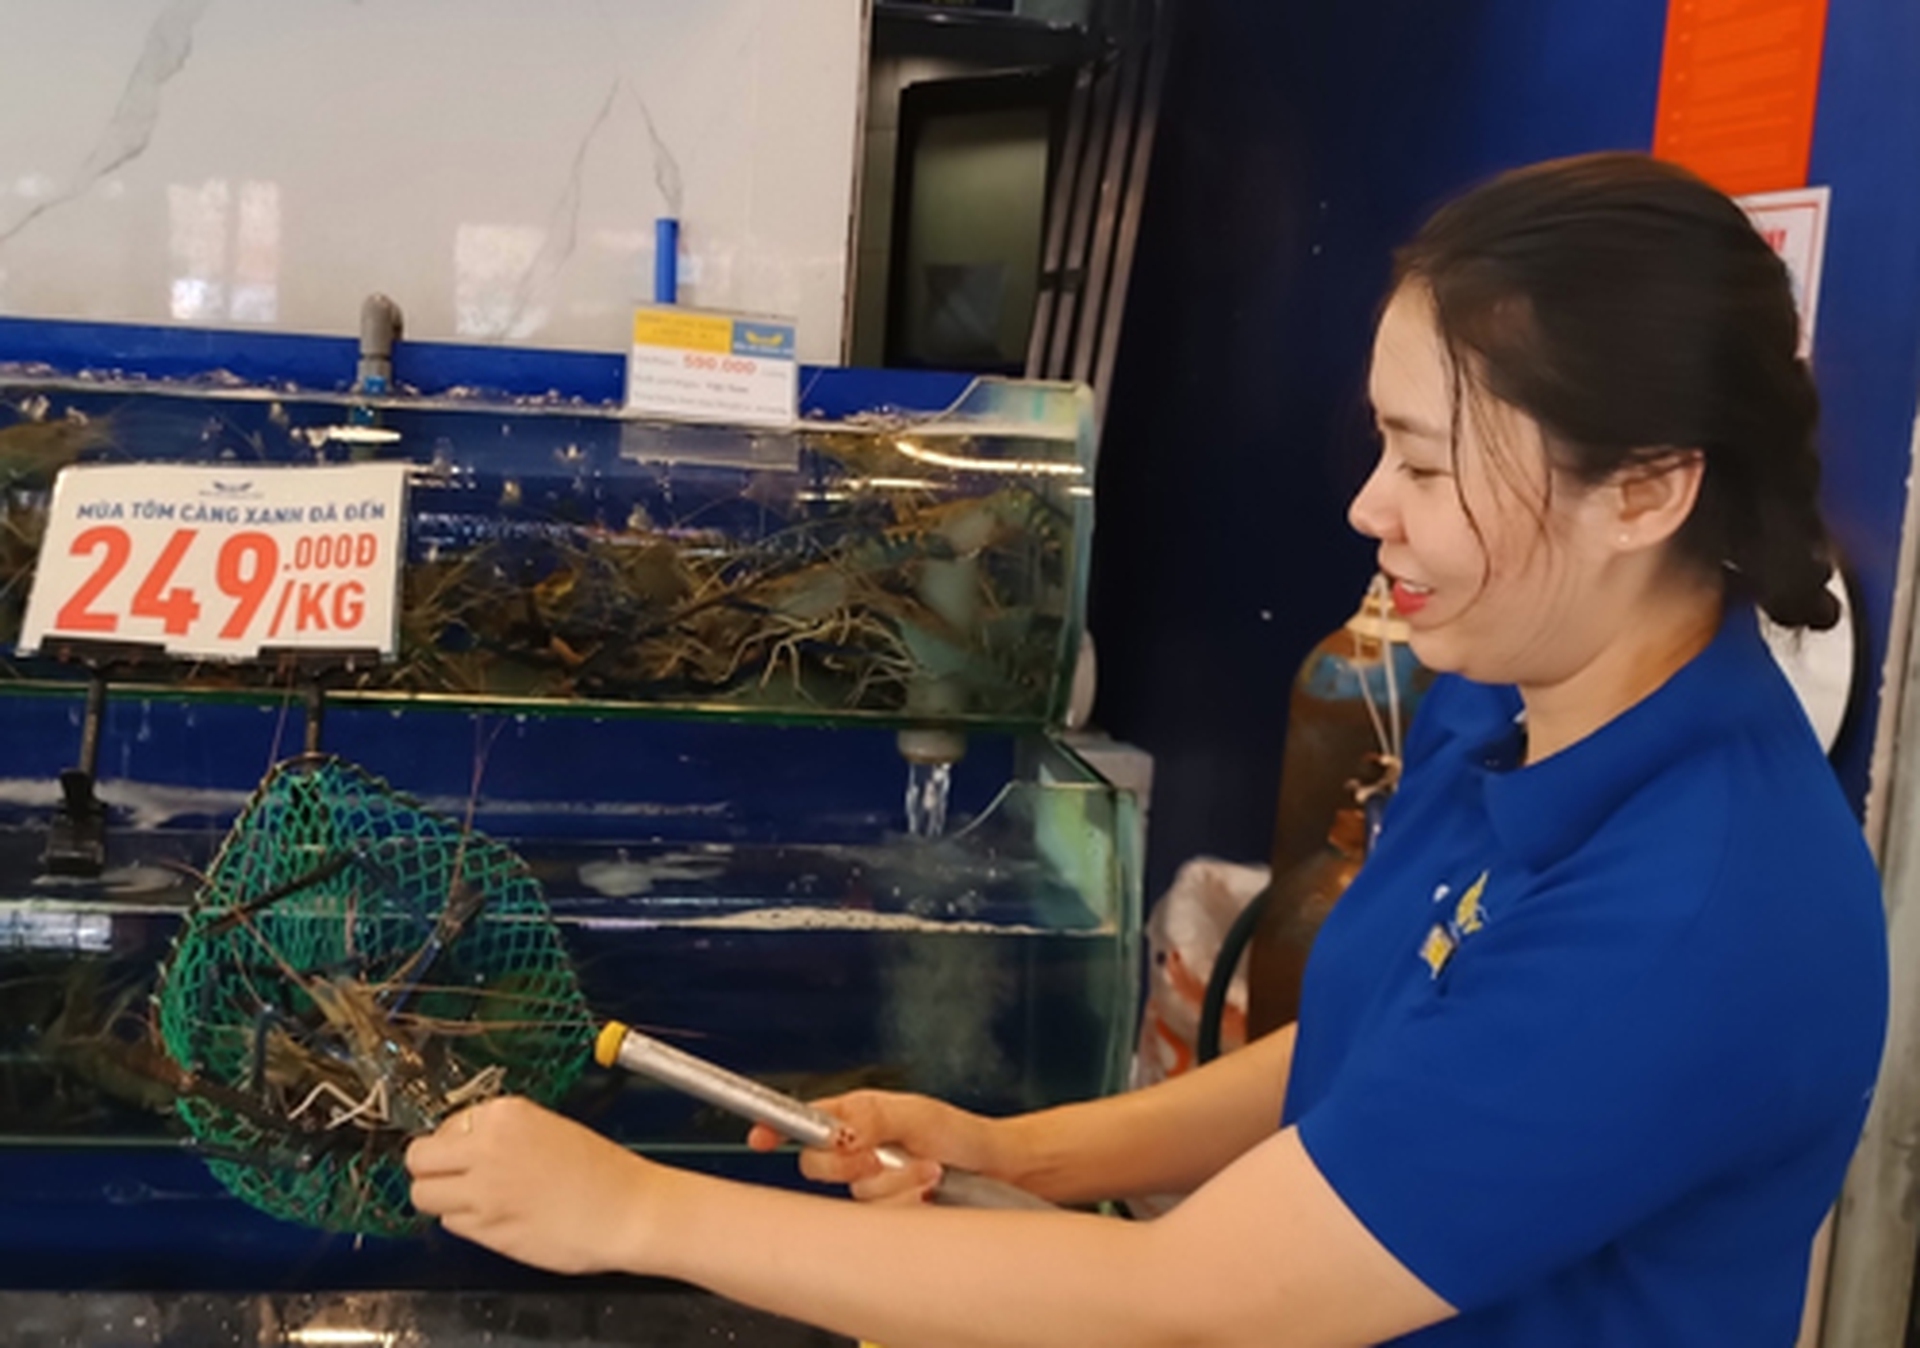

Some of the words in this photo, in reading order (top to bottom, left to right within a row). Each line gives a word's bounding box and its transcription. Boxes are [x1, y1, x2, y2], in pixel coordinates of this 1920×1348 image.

[683, 353, 757, 376] 590.000
[244, 505, 305, 524] XANH
[54, 525, 280, 640] 249
[267, 580, 366, 638] /KG
